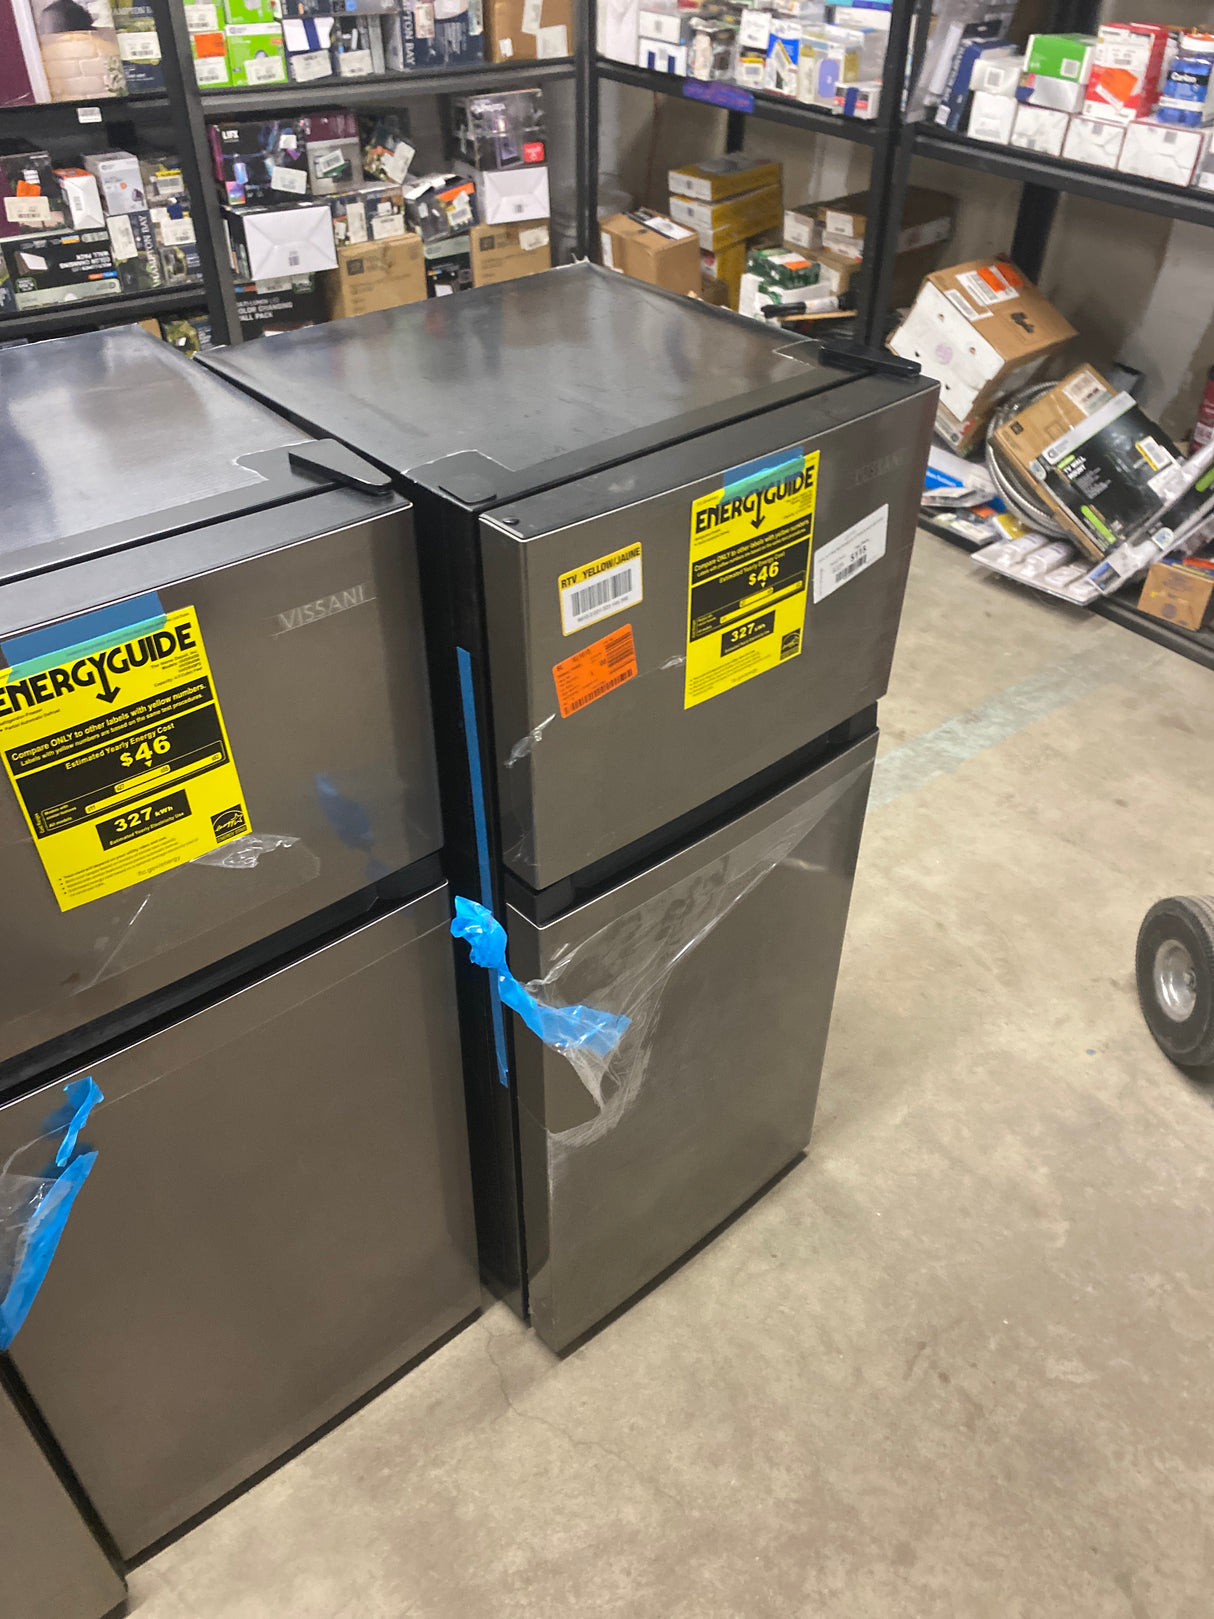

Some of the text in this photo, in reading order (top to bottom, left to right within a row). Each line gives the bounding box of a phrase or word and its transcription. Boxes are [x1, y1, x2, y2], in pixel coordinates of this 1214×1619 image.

[696, 465, 815, 534] ENERGYGUIDE
[561, 547, 641, 589] RTV YELLOW/JAUNE
[748, 561, 779, 586] $46
[279, 584, 365, 628] VISSANI
[731, 622, 755, 643] 327
[11, 683, 206, 762] Compare ONLY to other labels with yellow numbers.
[20, 756, 40, 766] Labels
[55, 744, 74, 754] yellow
[65, 723, 174, 769] Estimated Yearly Energy Cost
[120, 735, 171, 767] $46
[114, 805, 174, 833] 327 kWh
